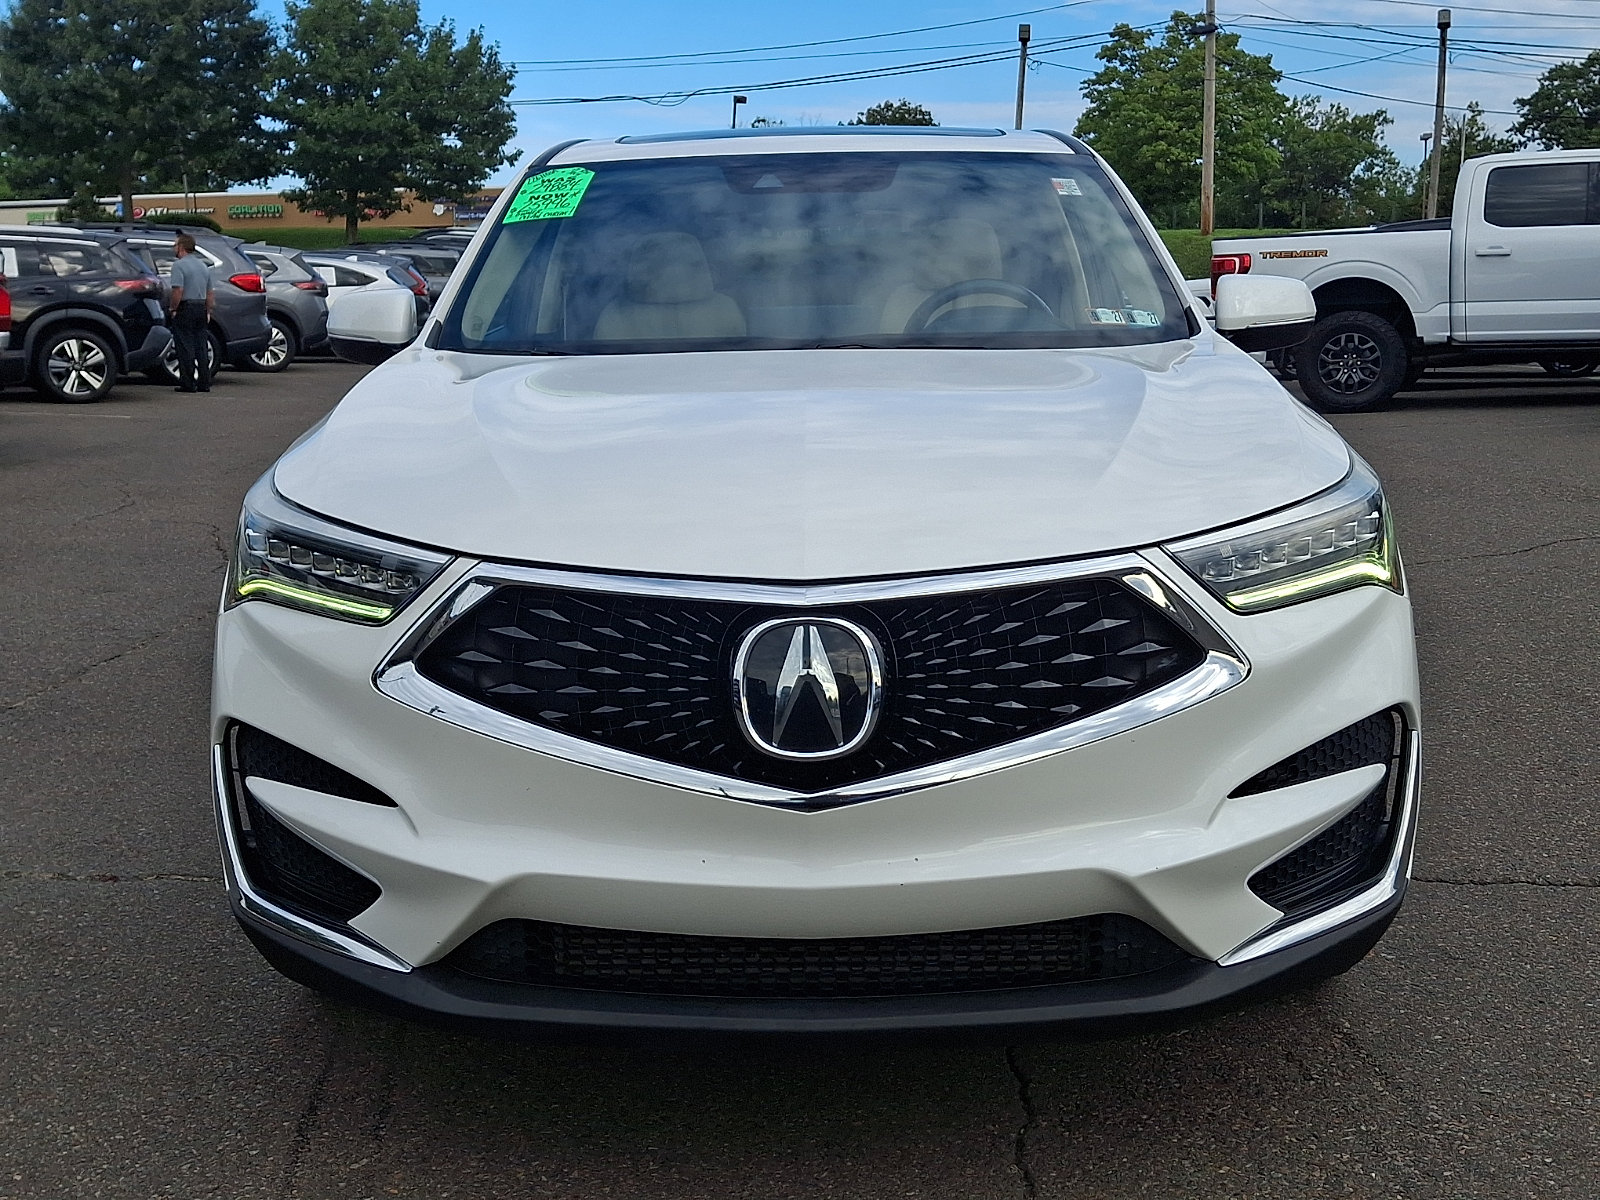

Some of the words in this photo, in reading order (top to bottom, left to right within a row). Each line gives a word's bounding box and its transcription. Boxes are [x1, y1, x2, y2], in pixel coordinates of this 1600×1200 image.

[541, 176, 576, 184] WAS
[529, 191, 570, 201] NOW
[146, 207, 168, 217] ATI
[1259, 250, 1328, 259] TREMOR
